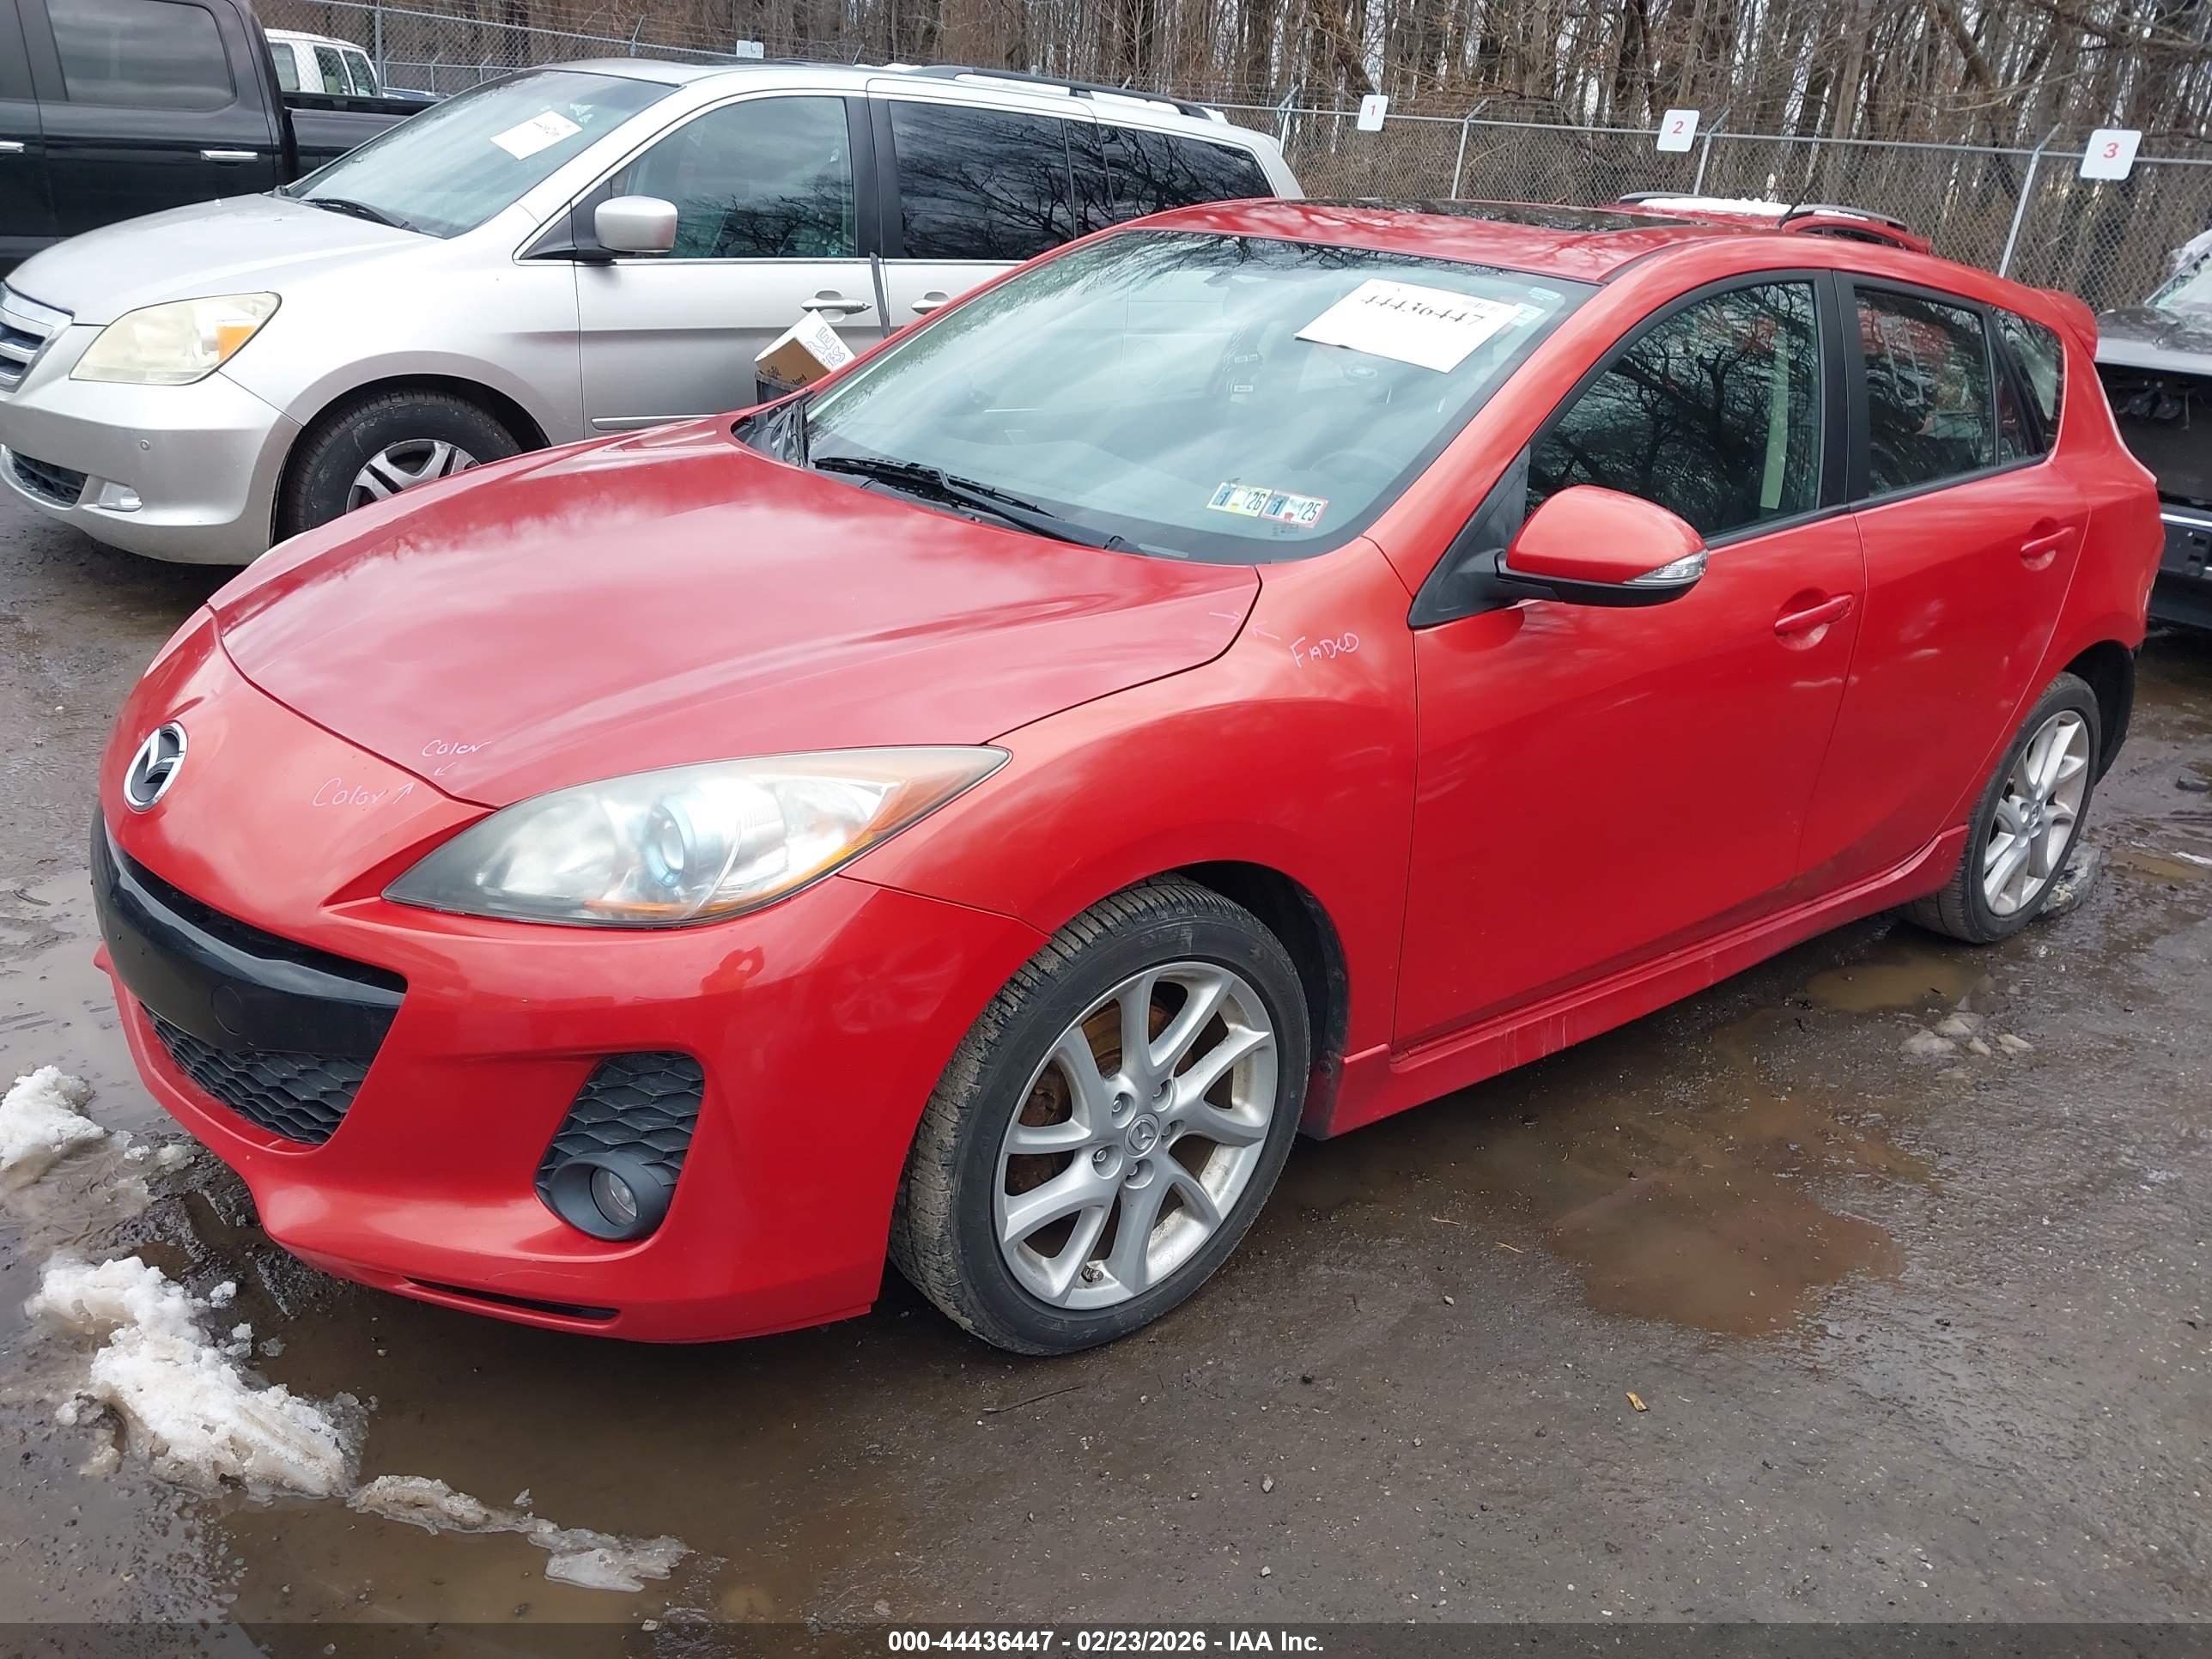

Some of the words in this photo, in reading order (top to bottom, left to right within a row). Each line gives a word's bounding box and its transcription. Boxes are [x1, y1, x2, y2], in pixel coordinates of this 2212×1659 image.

[1370, 104, 1376, 117] 1
[1673, 120, 1685, 134] 2
[2103, 143, 2119, 159] 3
[1360, 294, 1486, 326] 44436447
[1300, 501, 1322, 522] 25
[312, 777, 386, 807] Color
